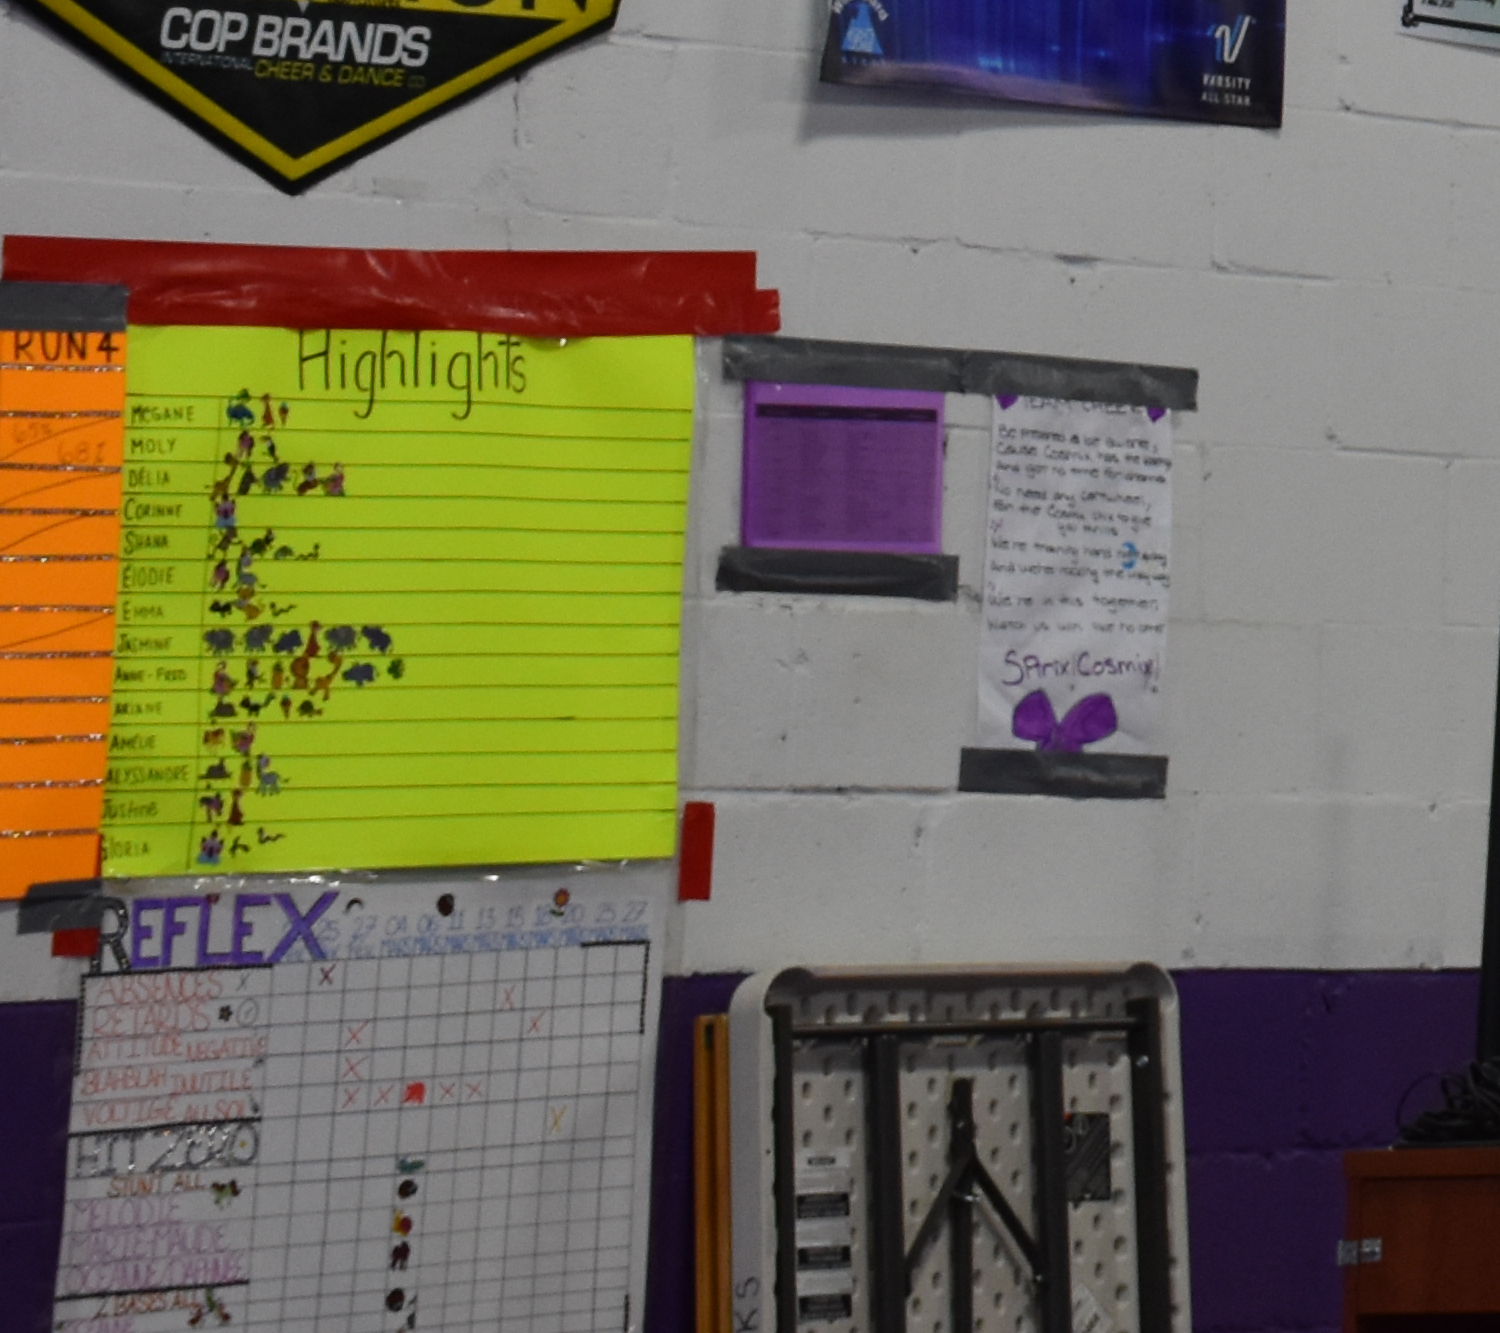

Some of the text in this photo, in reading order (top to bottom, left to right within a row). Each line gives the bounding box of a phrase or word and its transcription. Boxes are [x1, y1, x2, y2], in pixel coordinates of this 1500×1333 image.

[160, 7, 431, 67] COP BRANDS
[254, 59, 315, 81] CHEER
[338, 65, 405, 85] DANCE
[14, 332, 119, 362] RUN 4
[298, 329, 529, 421] Highlights
[129, 468, 170, 487] DÉLIA
[90, 891, 340, 973] REFLEX
[95, 972, 224, 1005] ABSENCES
